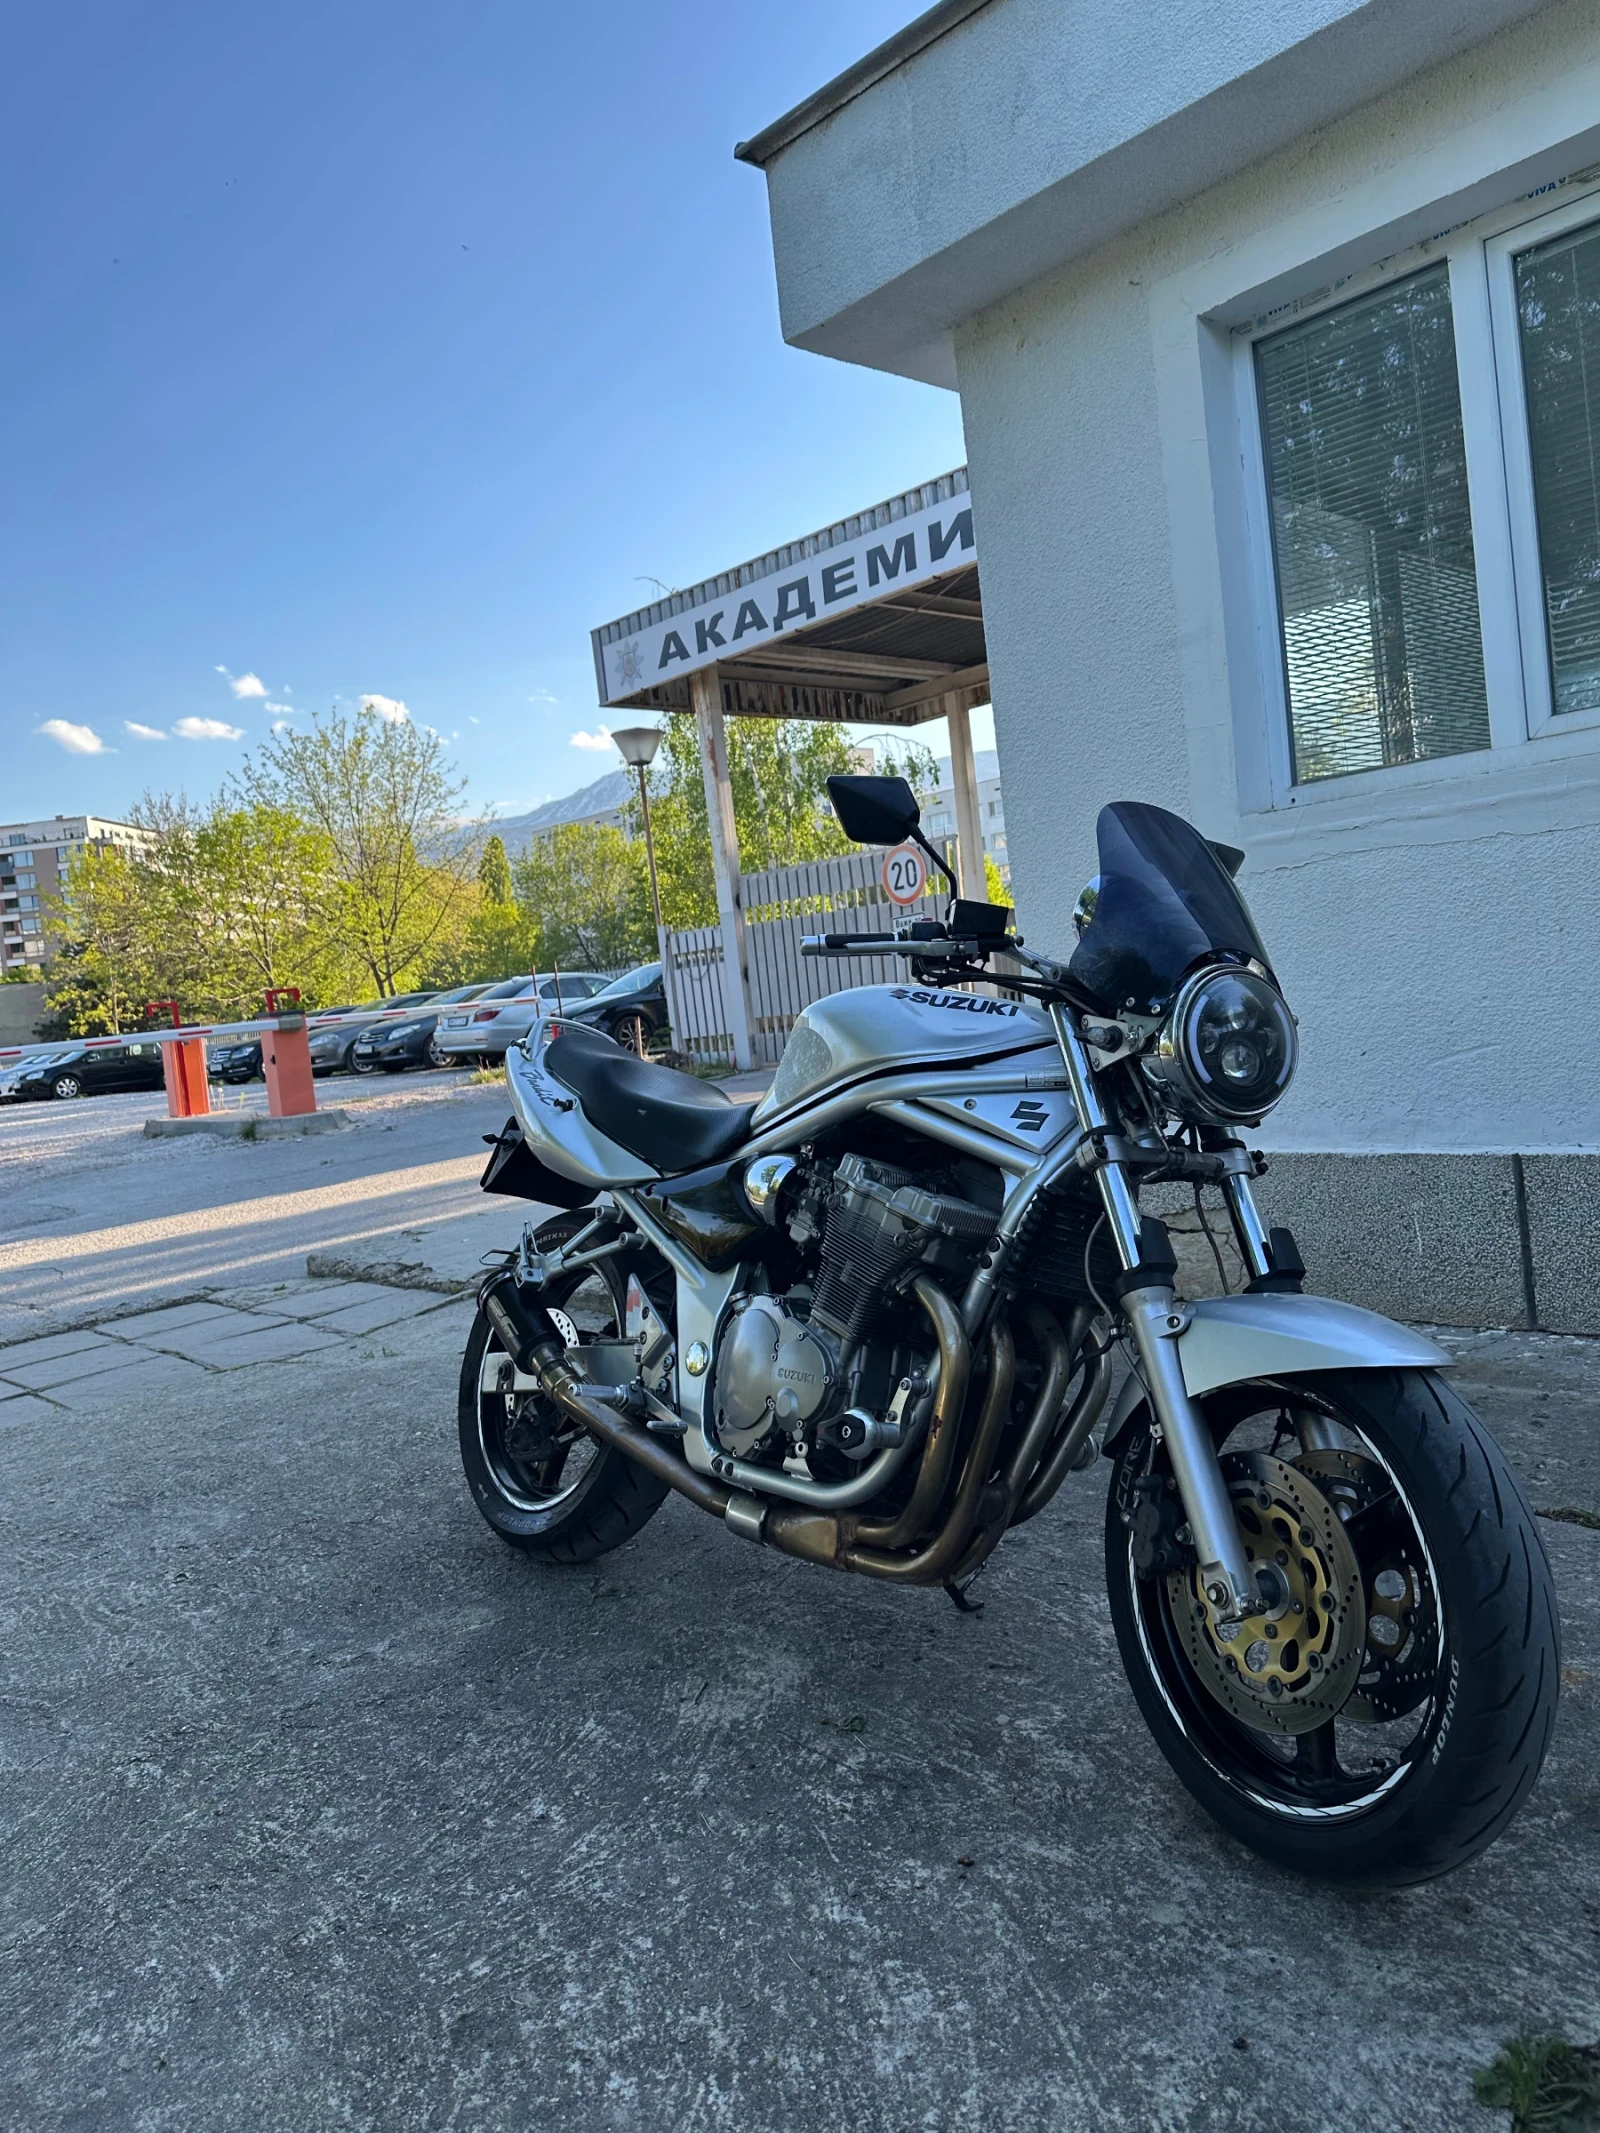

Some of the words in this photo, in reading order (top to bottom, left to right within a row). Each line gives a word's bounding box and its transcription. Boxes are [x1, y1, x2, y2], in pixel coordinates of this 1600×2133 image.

[657, 508, 975, 670] АКАДЕМИ
[891, 858, 918, 891] 20
[907, 990, 1020, 1017] SUZUKI
[518, 1068, 556, 1106] Bandit
[777, 1367, 816, 1386] SUZUKI
[1430, 1653, 1460, 1767] DUNLOP
